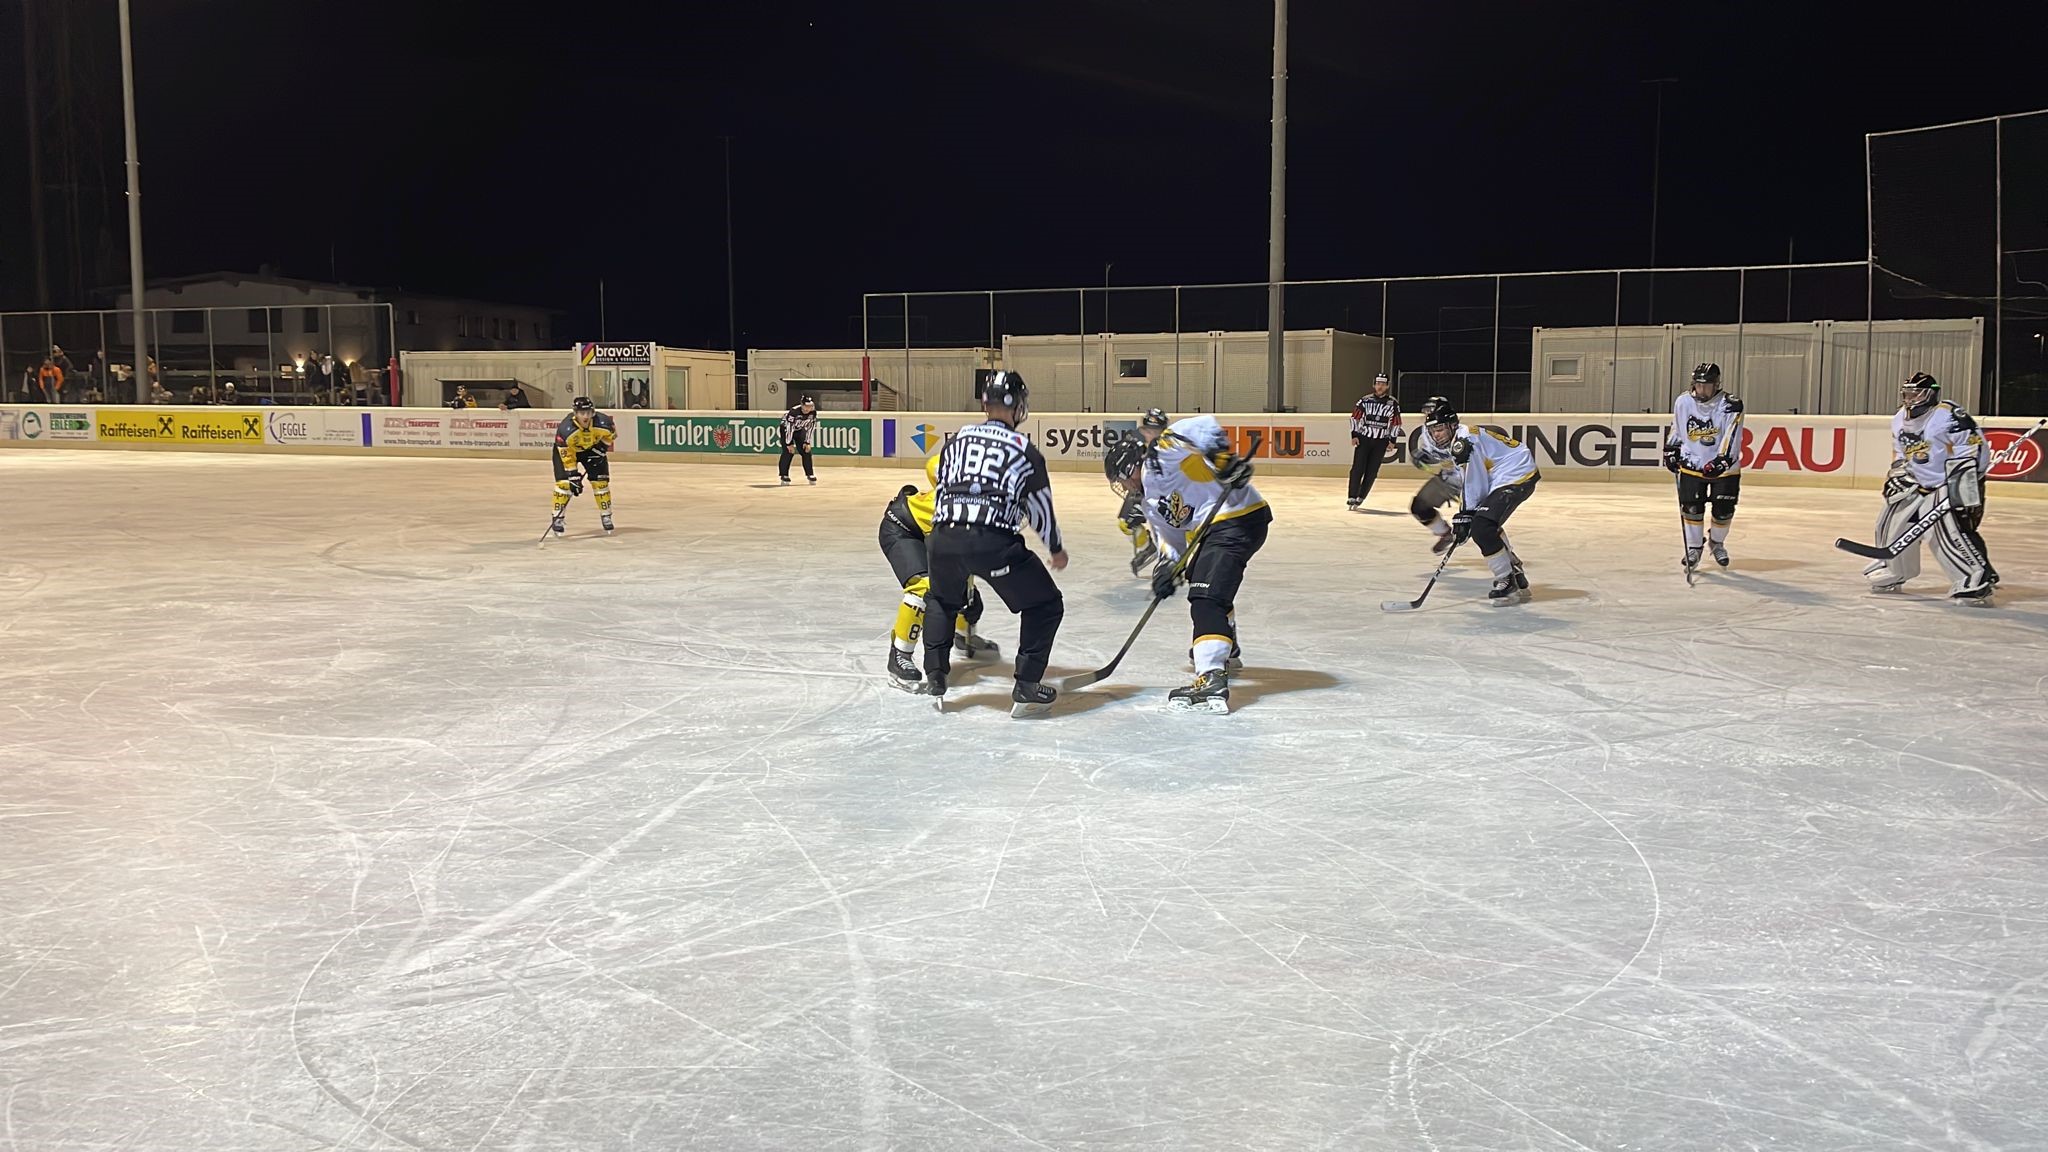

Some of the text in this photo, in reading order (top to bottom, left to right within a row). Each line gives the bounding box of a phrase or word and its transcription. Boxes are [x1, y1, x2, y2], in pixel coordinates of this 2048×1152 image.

[596, 345, 650, 357] bravoTEX
[100, 423, 242, 439] Raiffeisen Raiffeisen
[279, 423, 307, 439] JEGGLE
[649, 419, 860, 454] Tiroler Tagestung
[964, 443, 1005, 480] 82
[1889, 500, 1950, 556] Reebok
